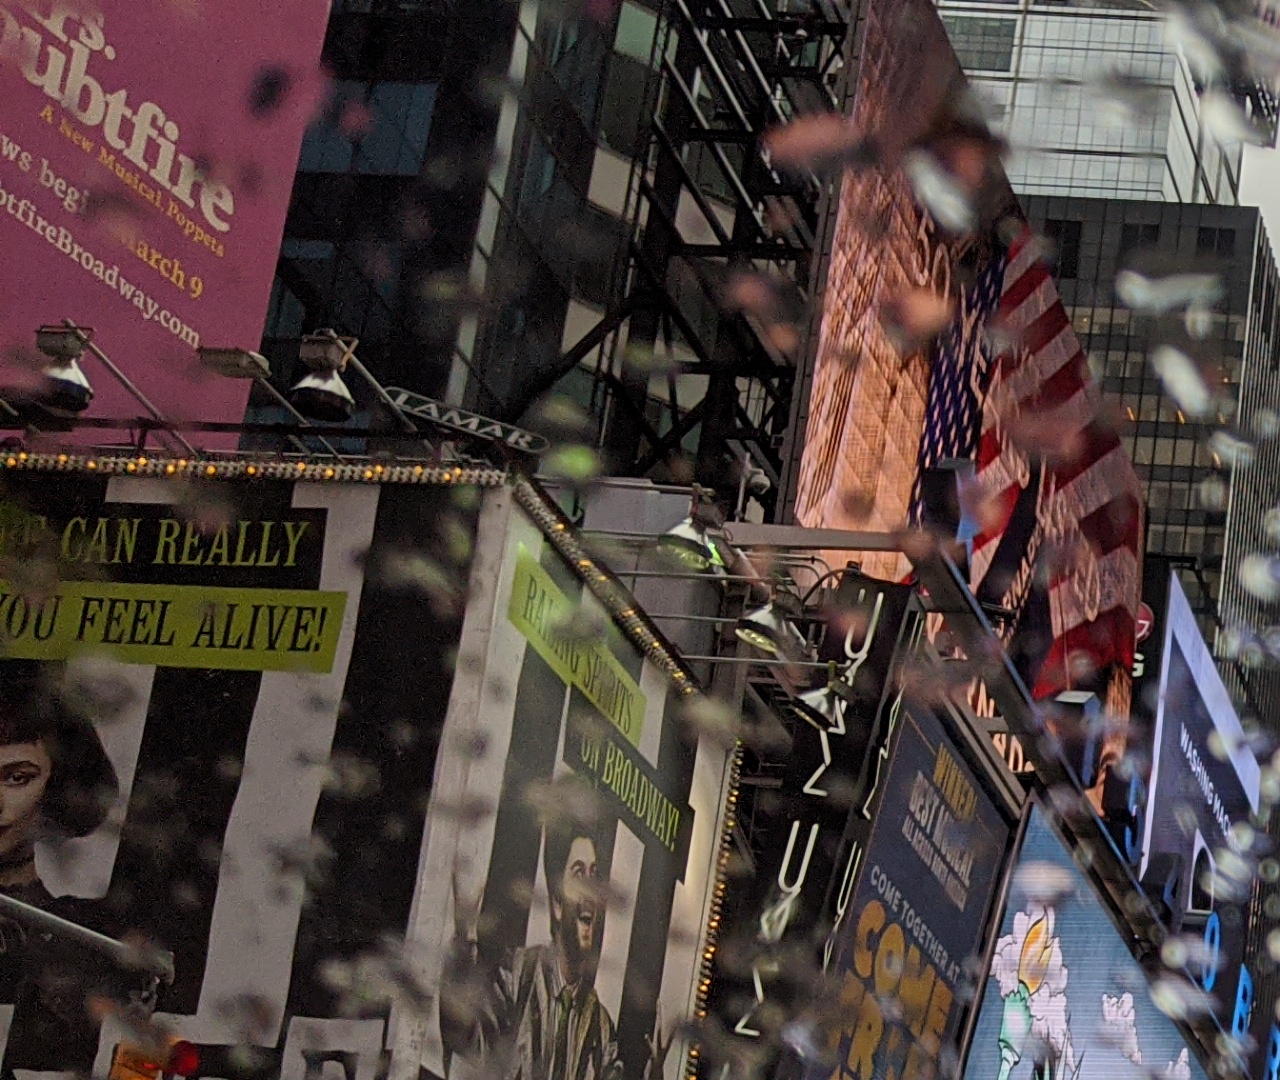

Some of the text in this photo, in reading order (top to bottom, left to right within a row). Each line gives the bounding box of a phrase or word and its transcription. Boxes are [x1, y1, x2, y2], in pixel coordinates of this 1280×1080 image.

[38, 157, 92, 218] begi
[189, 276, 204, 299] 9
[61, 516, 143, 564] CAN
[151, 518, 311, 567] REALLY
[76, 597, 178, 646] FEEL
[190, 602, 329, 652] ALIVE!
[602, 740, 682, 854] BROADWAY!
[909, 769, 941, 834] BEST
[1180, 721, 1214, 806] WASHING
[870, 865, 901, 912] COME
[901, 900, 948, 968] TOGETHER
